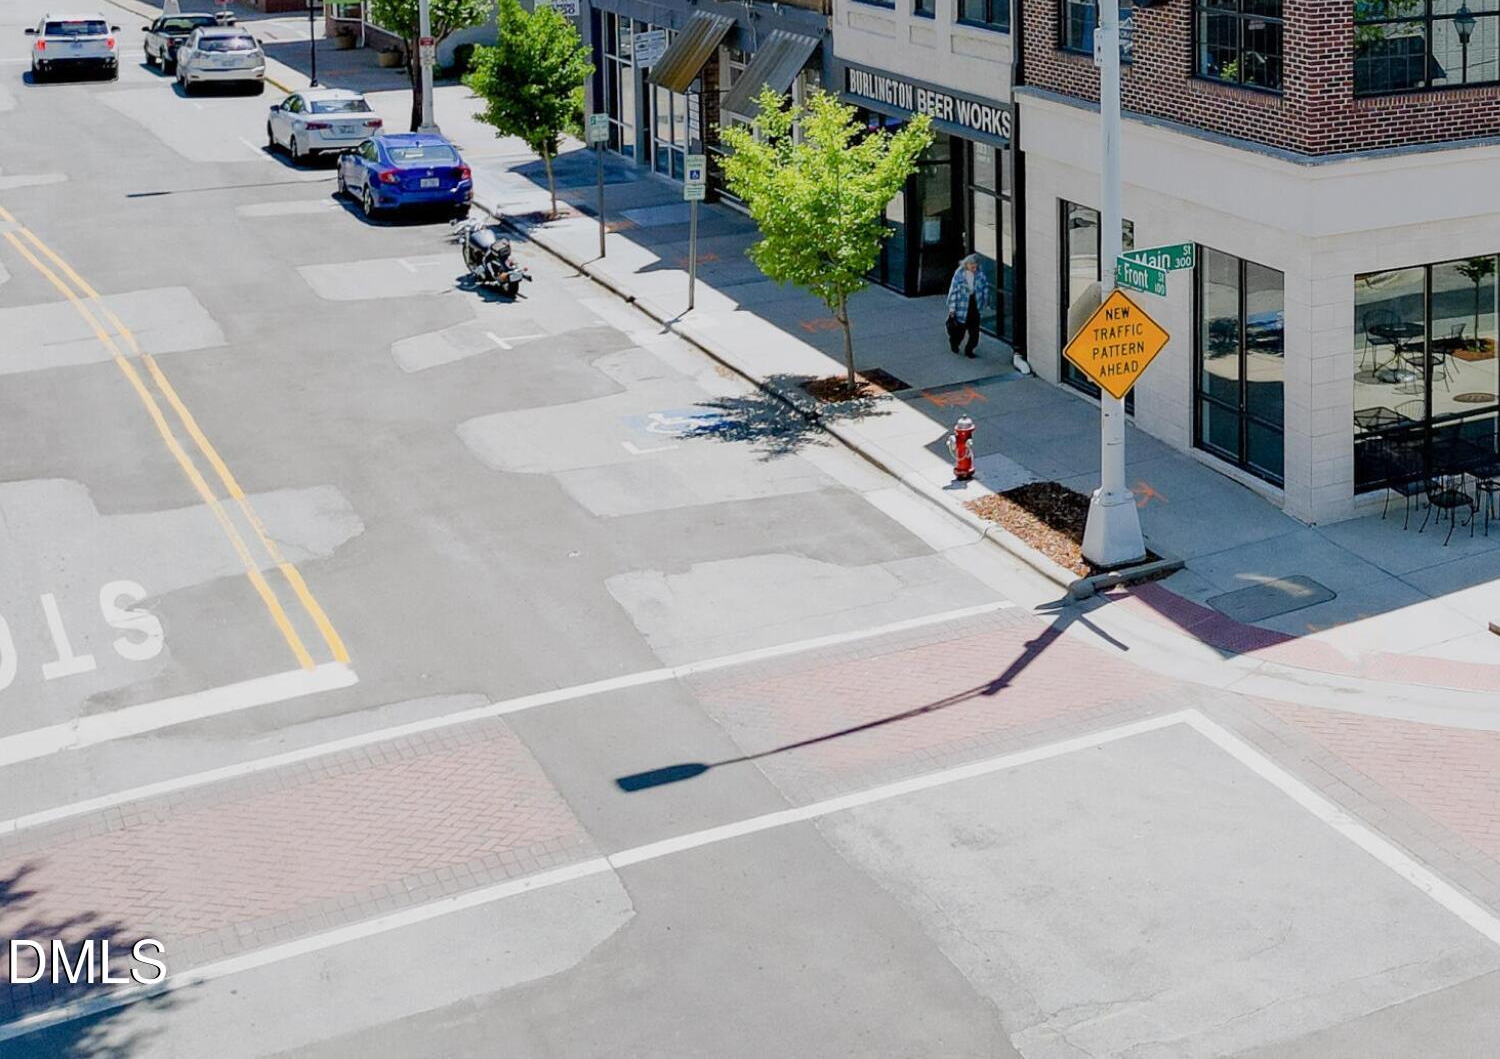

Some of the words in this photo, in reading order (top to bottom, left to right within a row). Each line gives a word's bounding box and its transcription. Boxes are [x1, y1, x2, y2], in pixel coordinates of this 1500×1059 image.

[849, 68, 913, 111] BURLINGTON
[916, 88, 954, 122] BEER
[956, 98, 1012, 139] WORKS
[1135, 251, 1171, 269] Main
[1183, 245, 1191, 256] St
[1175, 256, 1192, 268] 300
[1124, 262, 1149, 288] Front
[1154, 284, 1165, 295] 100
[1105, 307, 1130, 321] NEW
[1093, 323, 1144, 342] TRAFFIC
[1092, 342, 1144, 361] PATTERN
[1099, 360, 1139, 378] AHEAD
